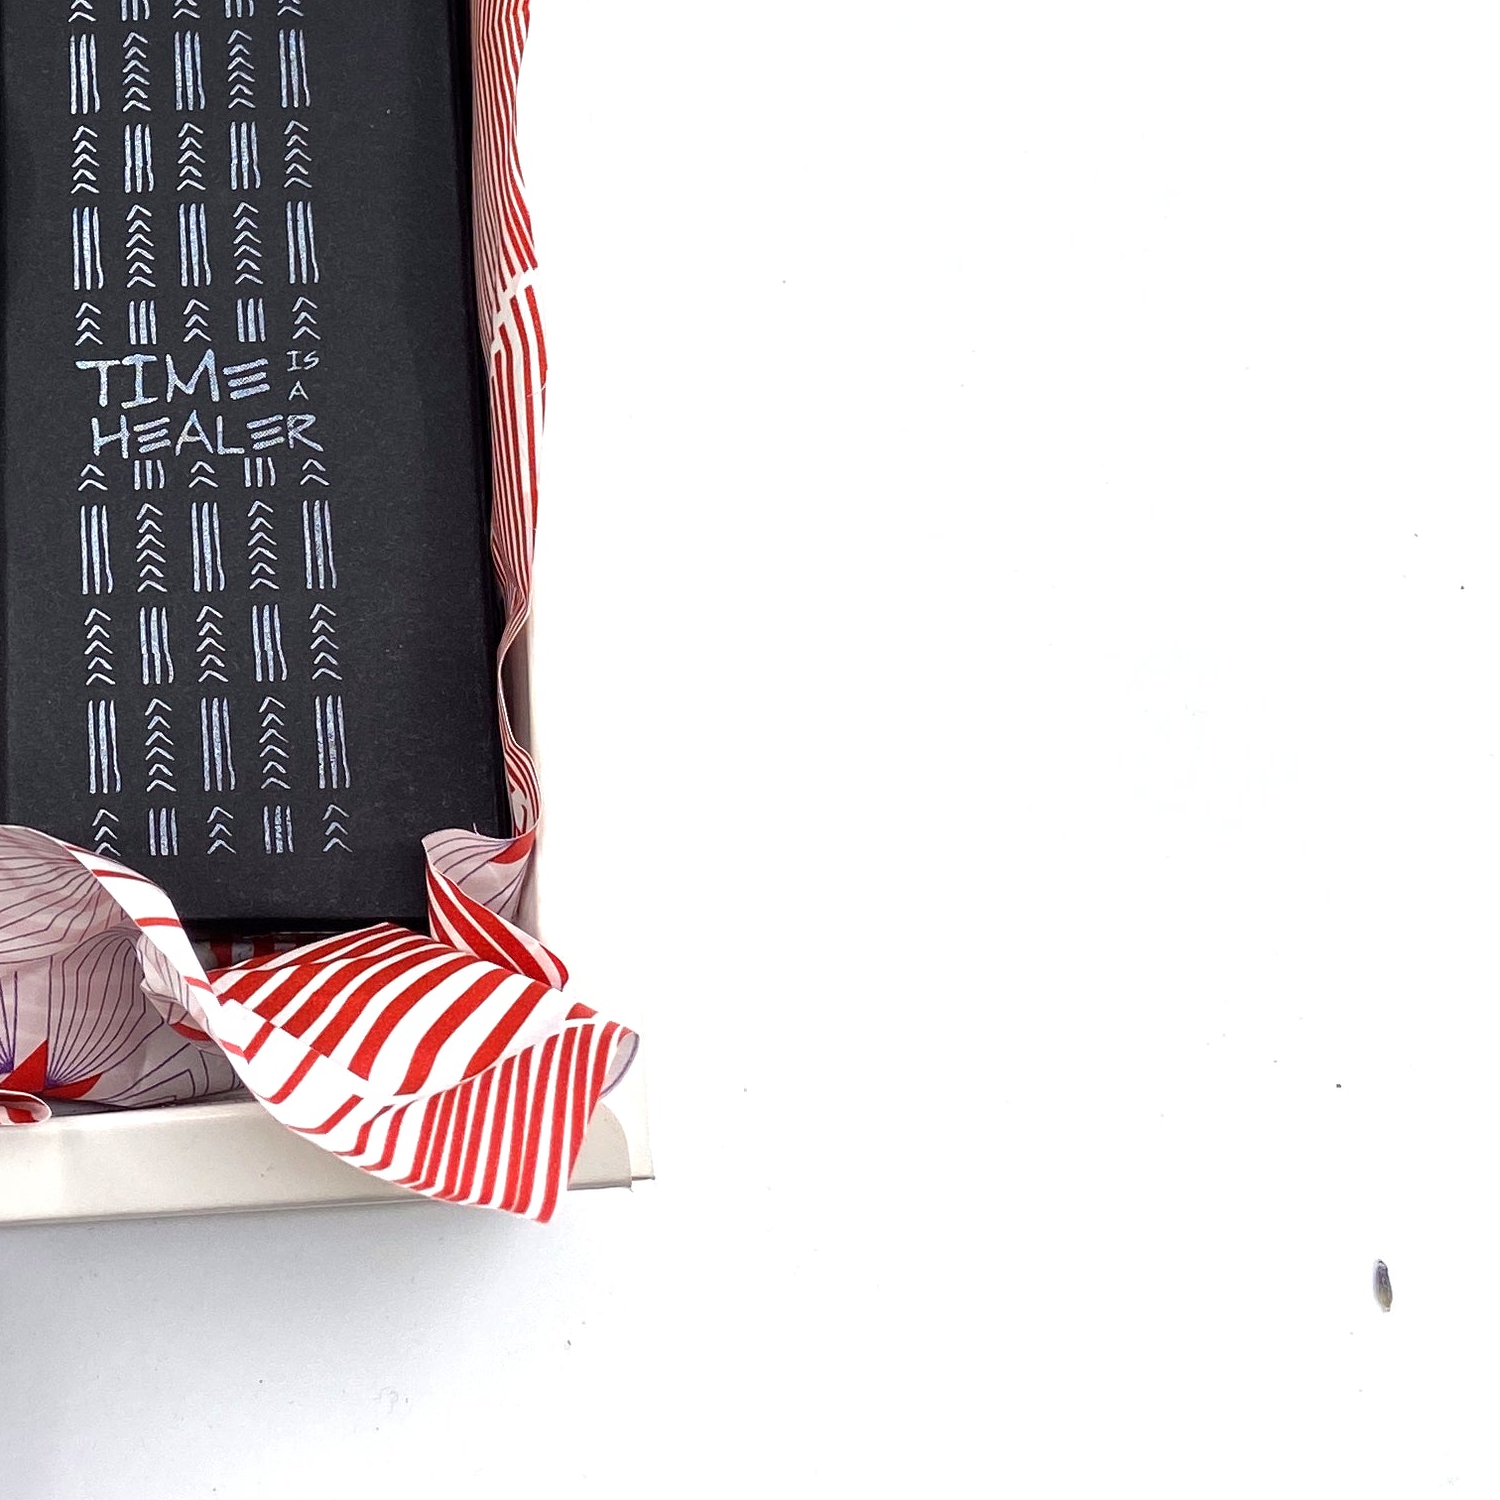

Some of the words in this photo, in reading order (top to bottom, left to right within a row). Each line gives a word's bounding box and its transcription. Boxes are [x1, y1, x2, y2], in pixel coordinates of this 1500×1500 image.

[75, 350, 271, 409] TIME
[287, 350, 320, 372] IS
[288, 380, 309, 400] A
[91, 410, 324, 459] HEALER
